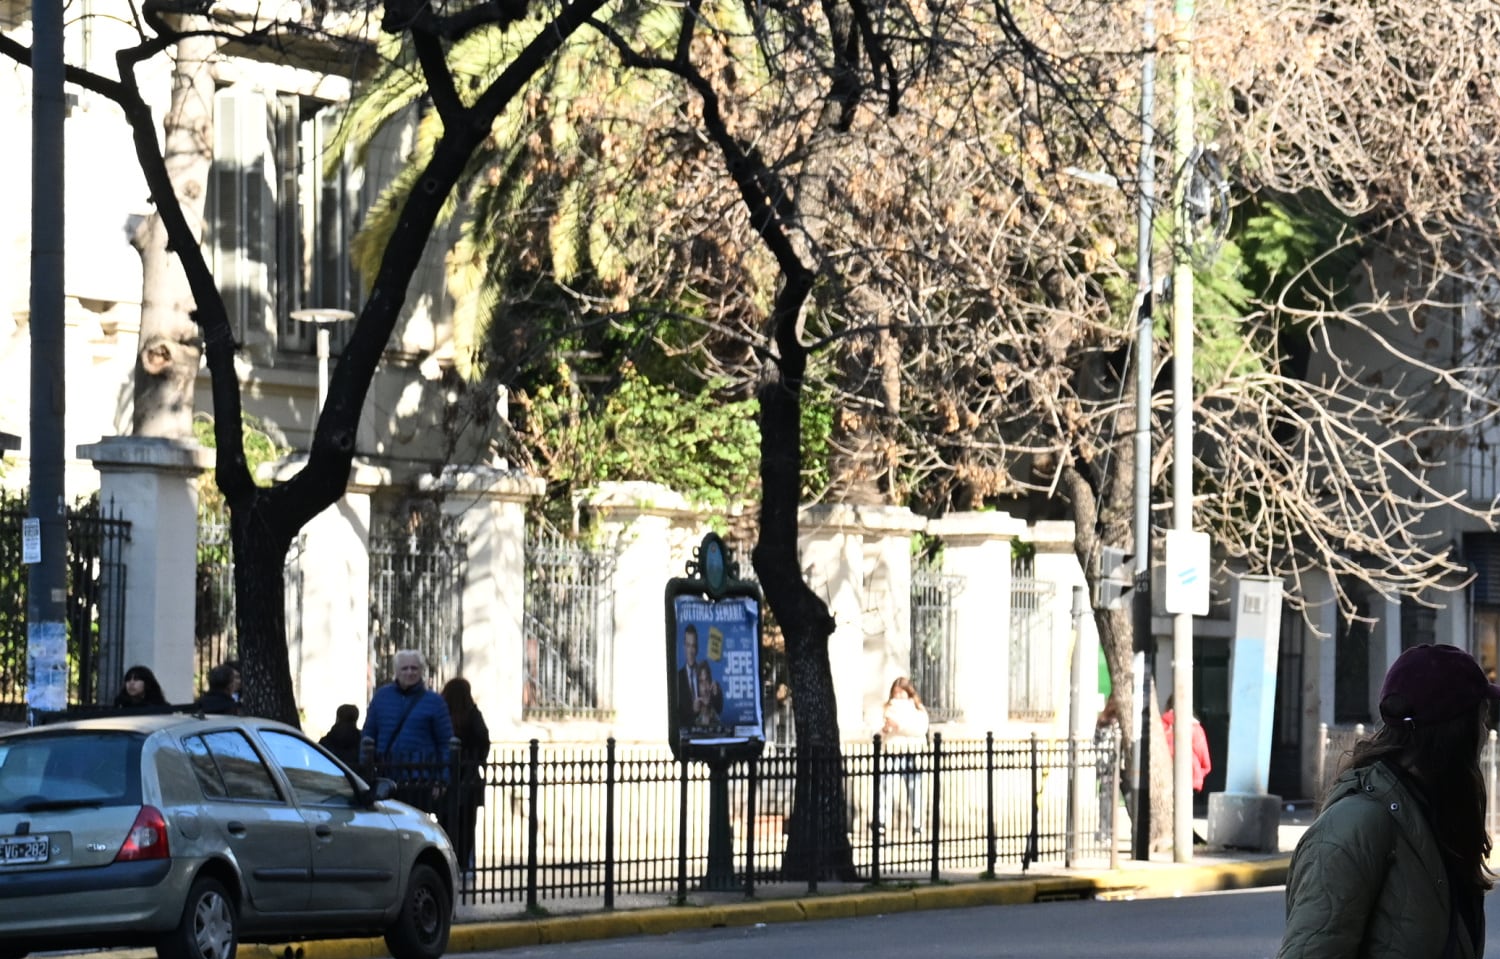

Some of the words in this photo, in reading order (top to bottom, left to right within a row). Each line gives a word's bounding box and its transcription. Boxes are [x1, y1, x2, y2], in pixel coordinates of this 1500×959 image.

[725, 651, 752, 674] JEFE
[726, 676, 754, 699] JEFE
[25, 842, 46, 857] 282
